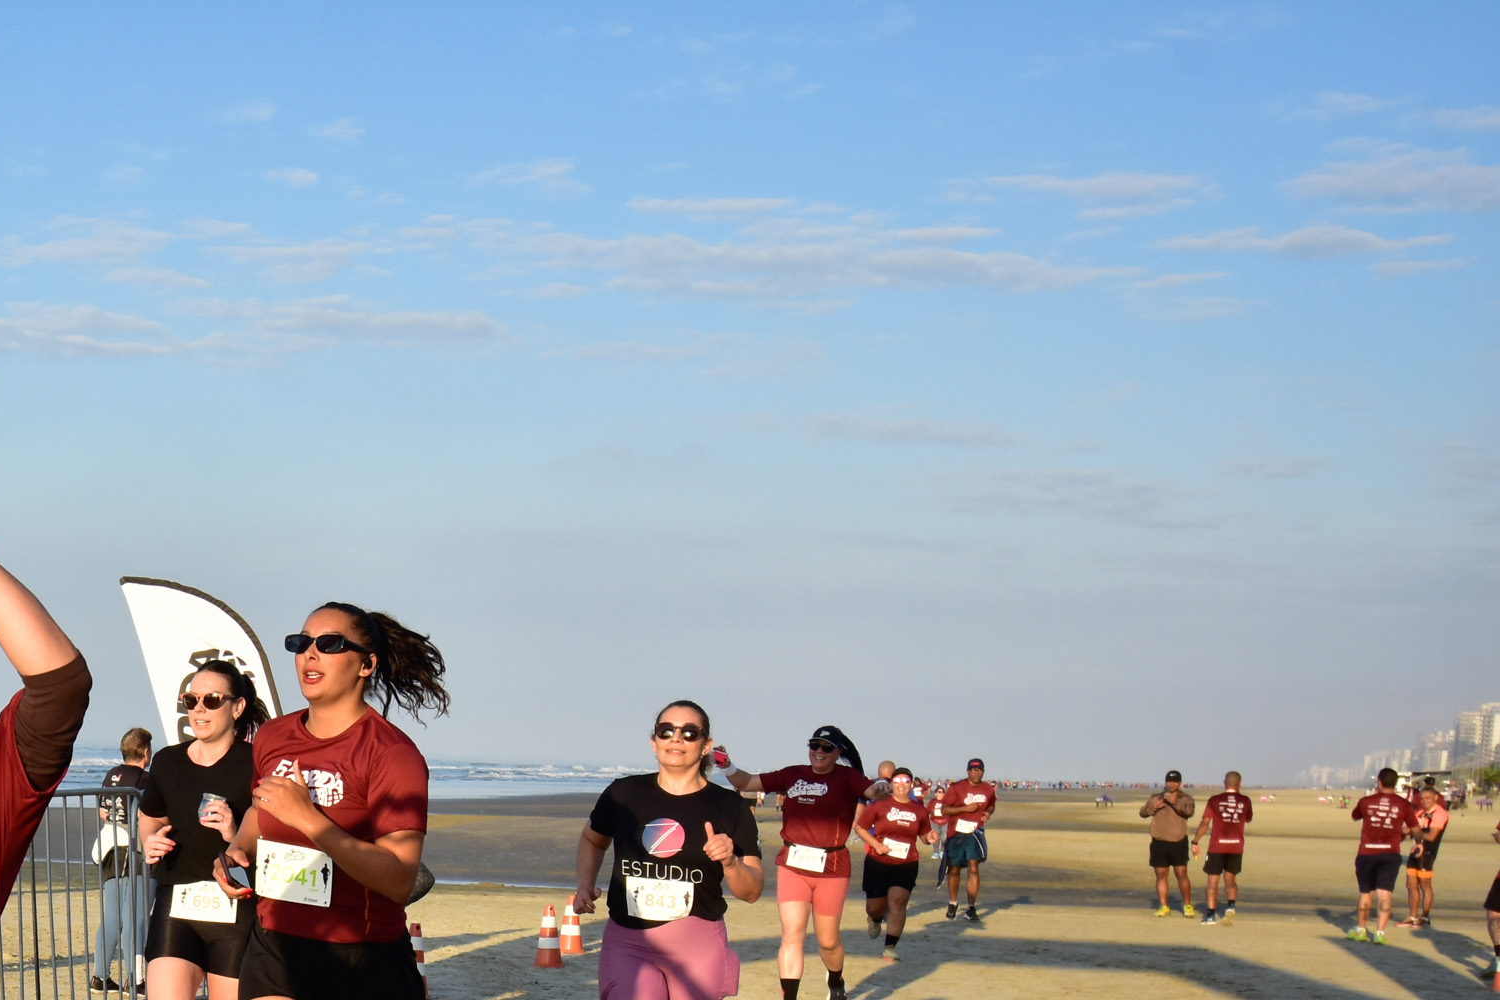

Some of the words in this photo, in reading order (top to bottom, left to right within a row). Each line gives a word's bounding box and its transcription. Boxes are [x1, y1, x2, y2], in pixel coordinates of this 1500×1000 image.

[270, 863, 318, 888] 2041
[621, 859, 704, 884] ESTUDIO
[192, 895, 221, 910] 695
[644, 893, 676, 909] 843
